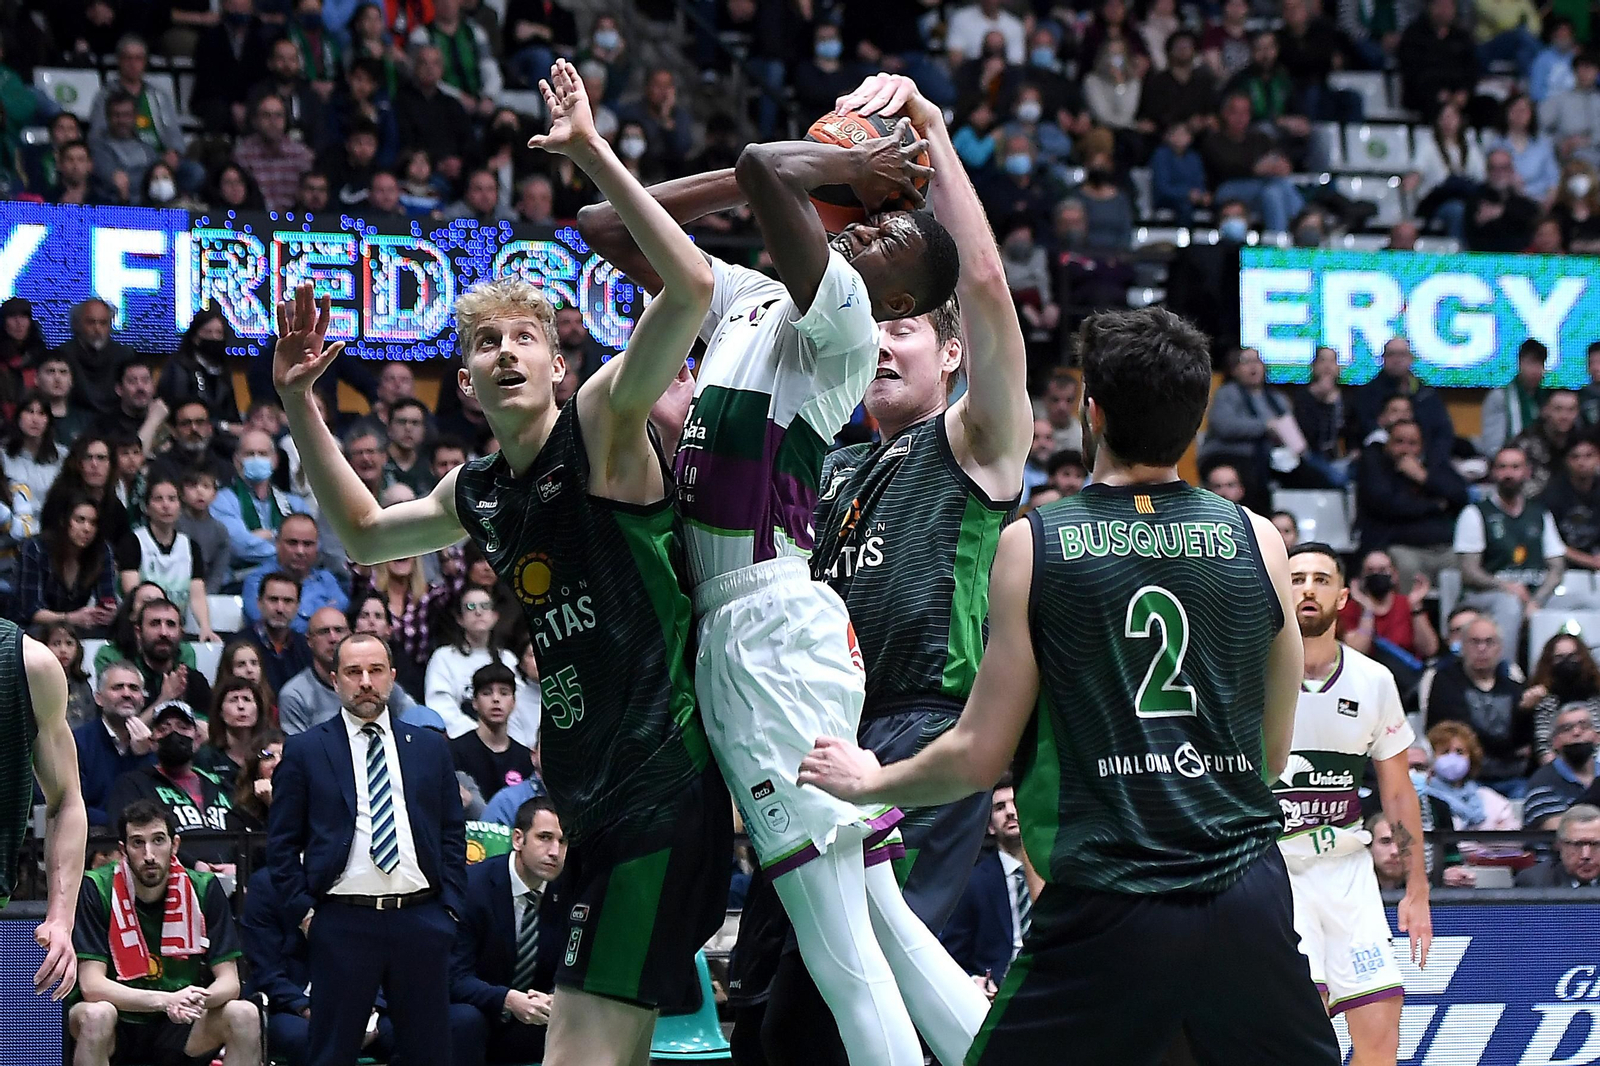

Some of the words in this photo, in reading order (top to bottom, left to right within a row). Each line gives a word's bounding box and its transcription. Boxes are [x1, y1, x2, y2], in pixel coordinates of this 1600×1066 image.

[832, 117, 869, 144] 100
[1240, 268, 1589, 372] ERGY
[1058, 520, 1238, 560] BUSQUETS
[1125, 585, 1198, 719] 2
[541, 664, 585, 730] 55
[754, 787, 770, 799] acb
[1309, 769, 1354, 788] Unicaja
